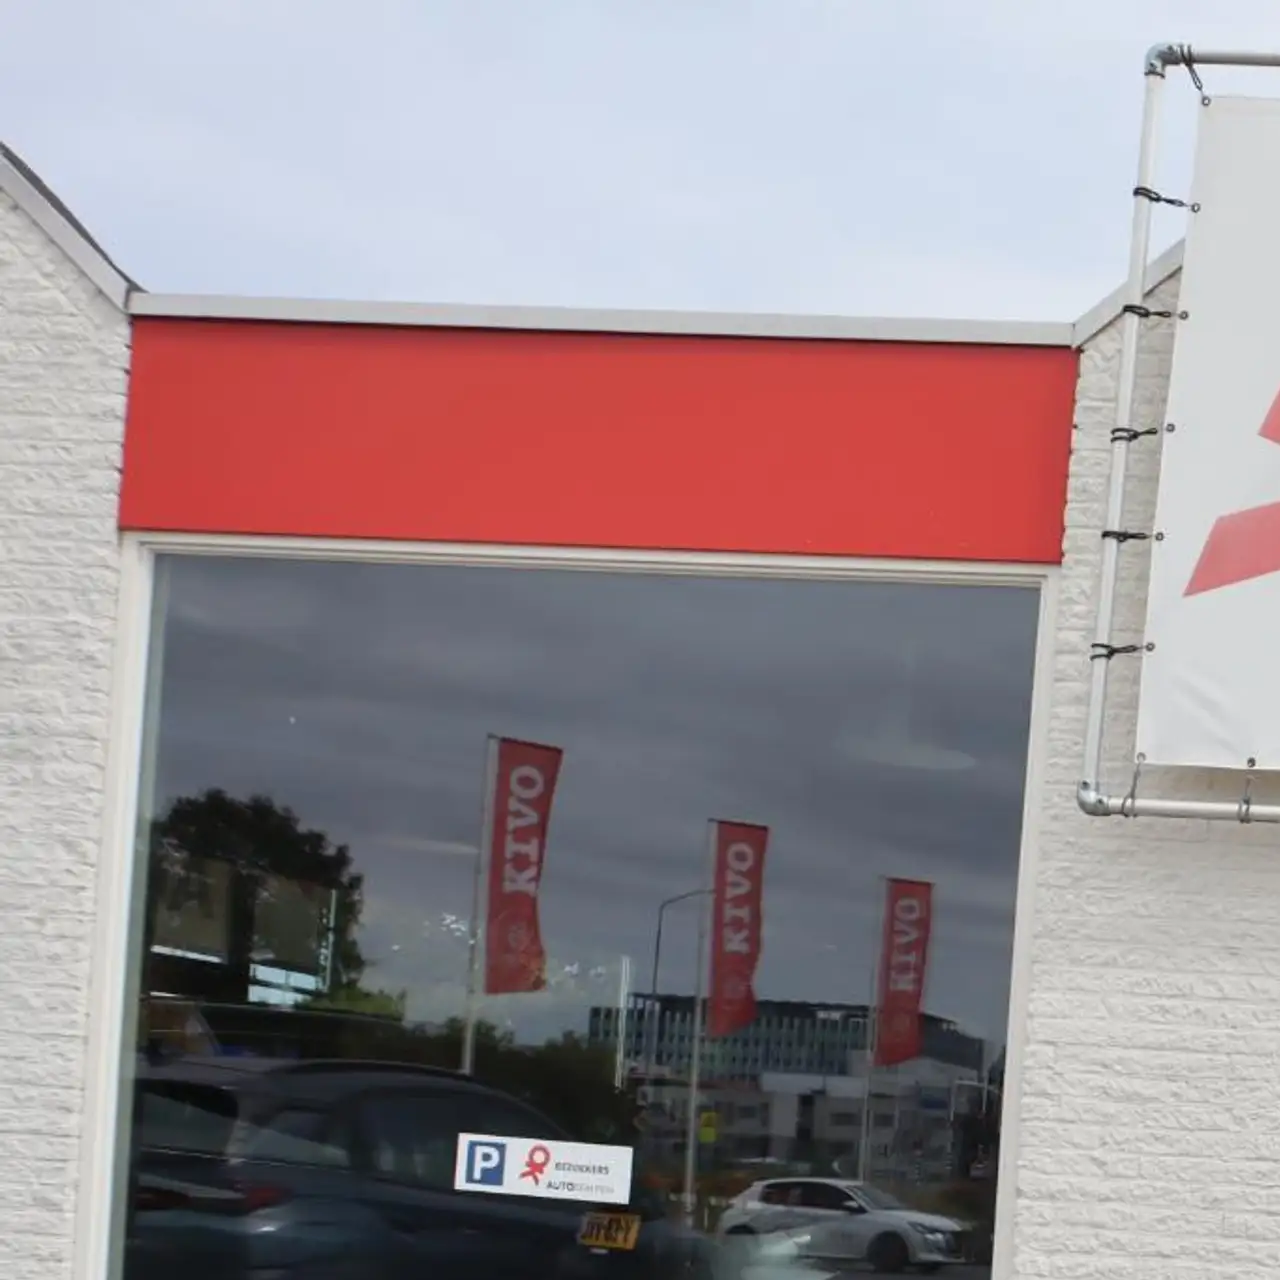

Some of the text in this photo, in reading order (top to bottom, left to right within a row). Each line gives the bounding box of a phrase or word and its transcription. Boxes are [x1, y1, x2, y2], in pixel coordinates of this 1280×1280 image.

[502, 765, 545, 897] KIVO
[723, 842, 754, 954] KIVO
[889, 897, 920, 991] KIVO
[473, 1144, 500, 1181] P
